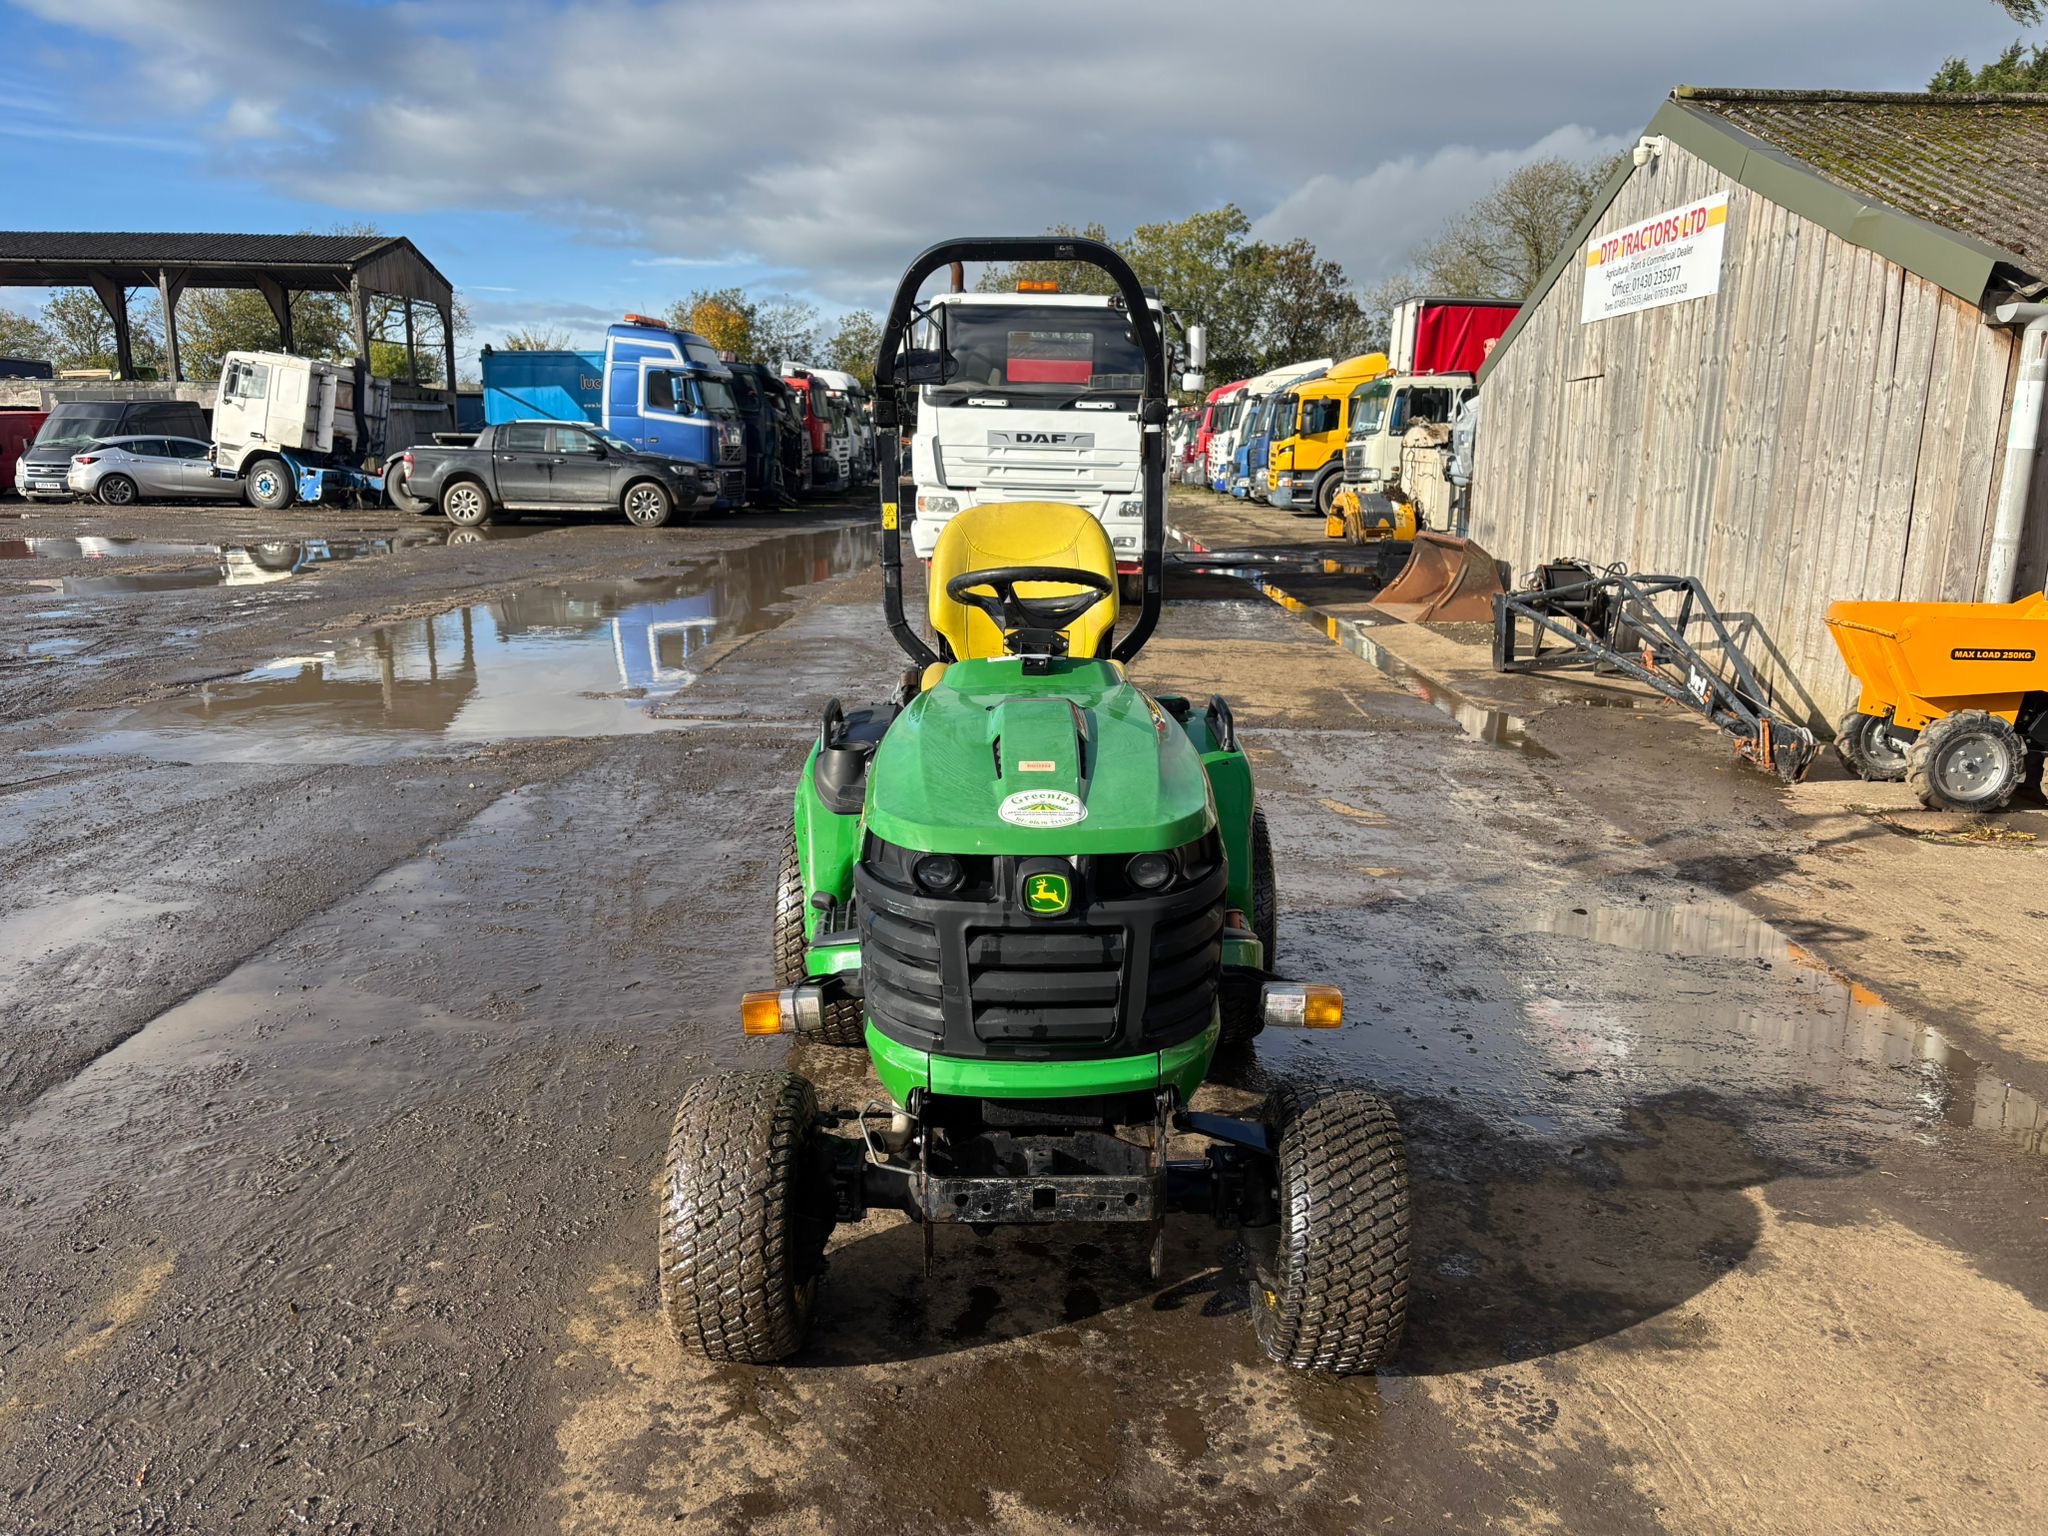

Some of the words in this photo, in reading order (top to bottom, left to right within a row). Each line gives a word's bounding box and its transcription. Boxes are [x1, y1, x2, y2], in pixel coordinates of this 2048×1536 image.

[1600, 239, 1619, 265] DTP
[1622, 216, 1680, 257] TRACTORS
[1682, 207, 1706, 238] LTD
[1647, 249, 1677, 267] Commercial
[1677, 244, 1694, 258] Dealer
[1612, 280, 1631, 297] Office:
[1632, 273, 1653, 291] 01430
[1653, 265, 1681, 286] 235977
[1016, 433, 1066, 444] DAF
[1954, 650, 1975, 659] MAX
[1976, 650, 2001, 659] LOAD
[2002, 651, 2032, 659] 250KG
[1010, 792, 1078, 806] Greenlay
